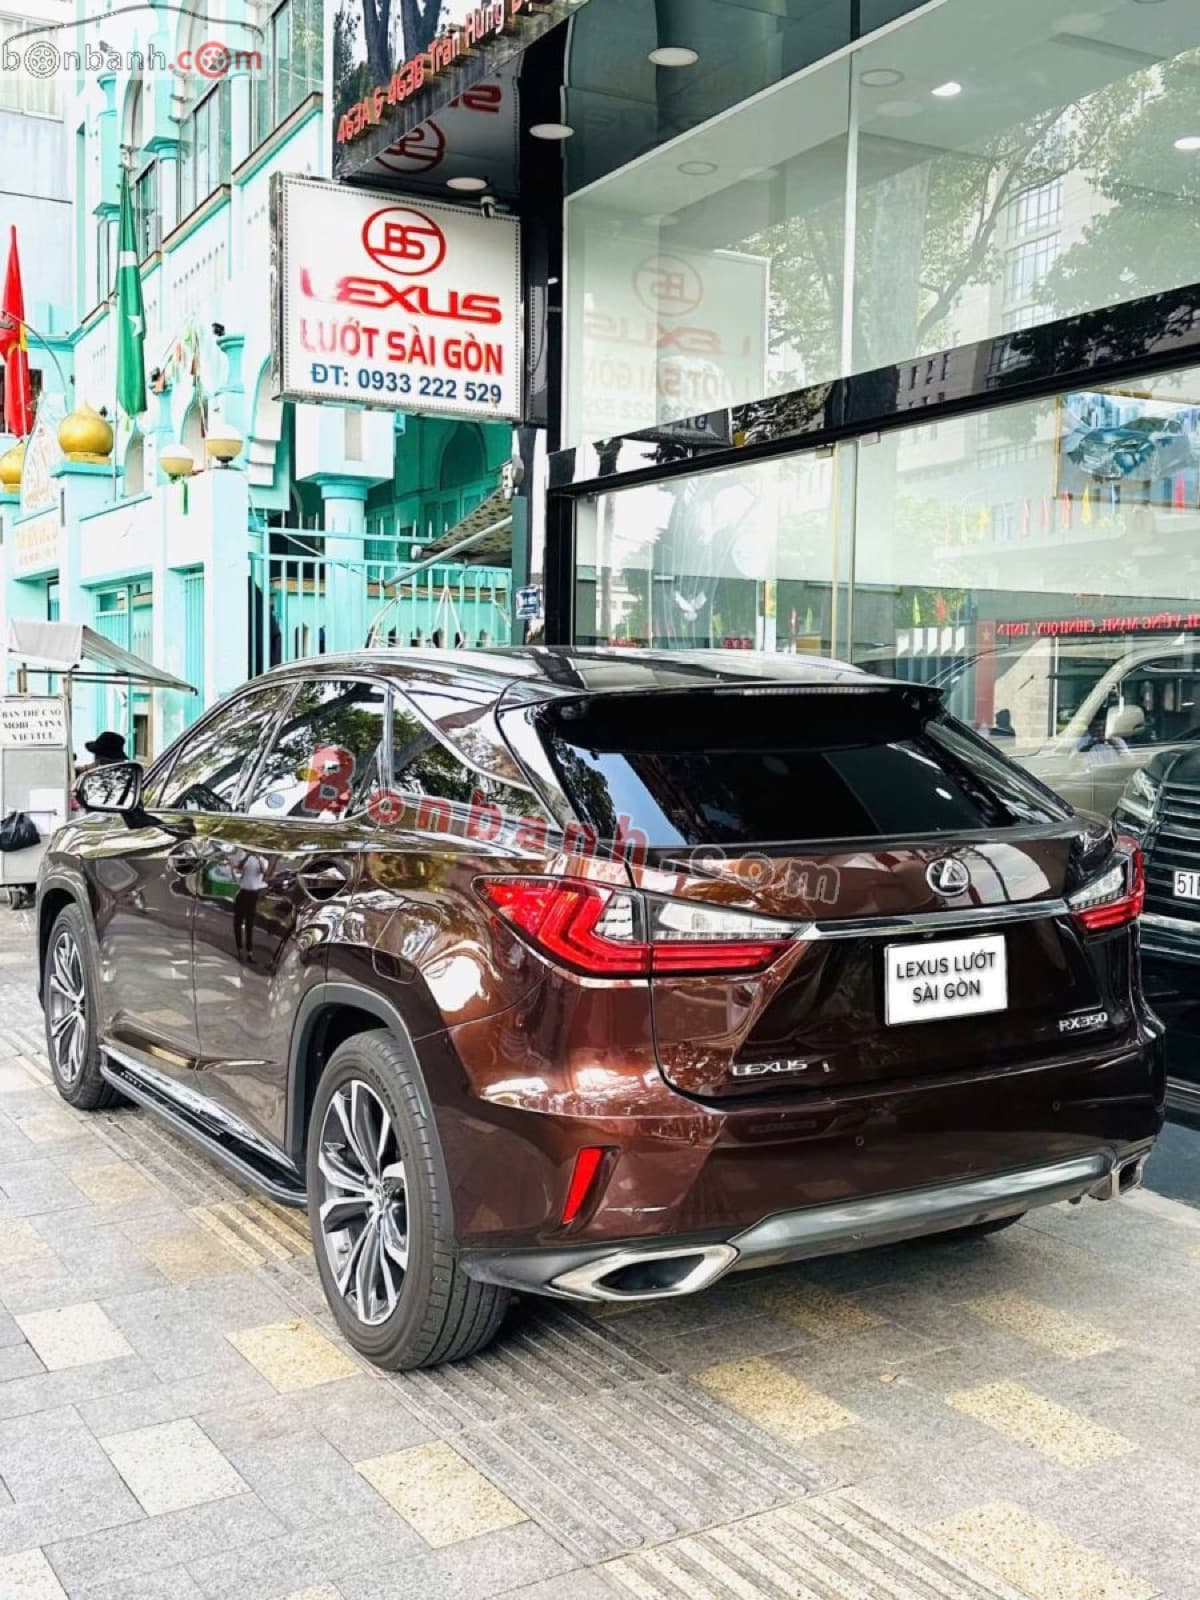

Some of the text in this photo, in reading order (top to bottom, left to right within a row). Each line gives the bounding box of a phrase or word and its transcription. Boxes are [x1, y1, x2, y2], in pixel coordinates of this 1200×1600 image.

[299, 265, 503, 325] LEXUS
[387, 323, 437, 367] SÀI
[443, 331, 504, 376] GÒN
[310, 362, 503, 404] ĐT: 0933 222 529
[896, 948, 997, 980] LEXUS LƯỚT
[912, 977, 982, 1004] SÀI GÒN
[1058, 1012, 1109, 1033] RX350
[732, 1060, 809, 1077] LEXUS
